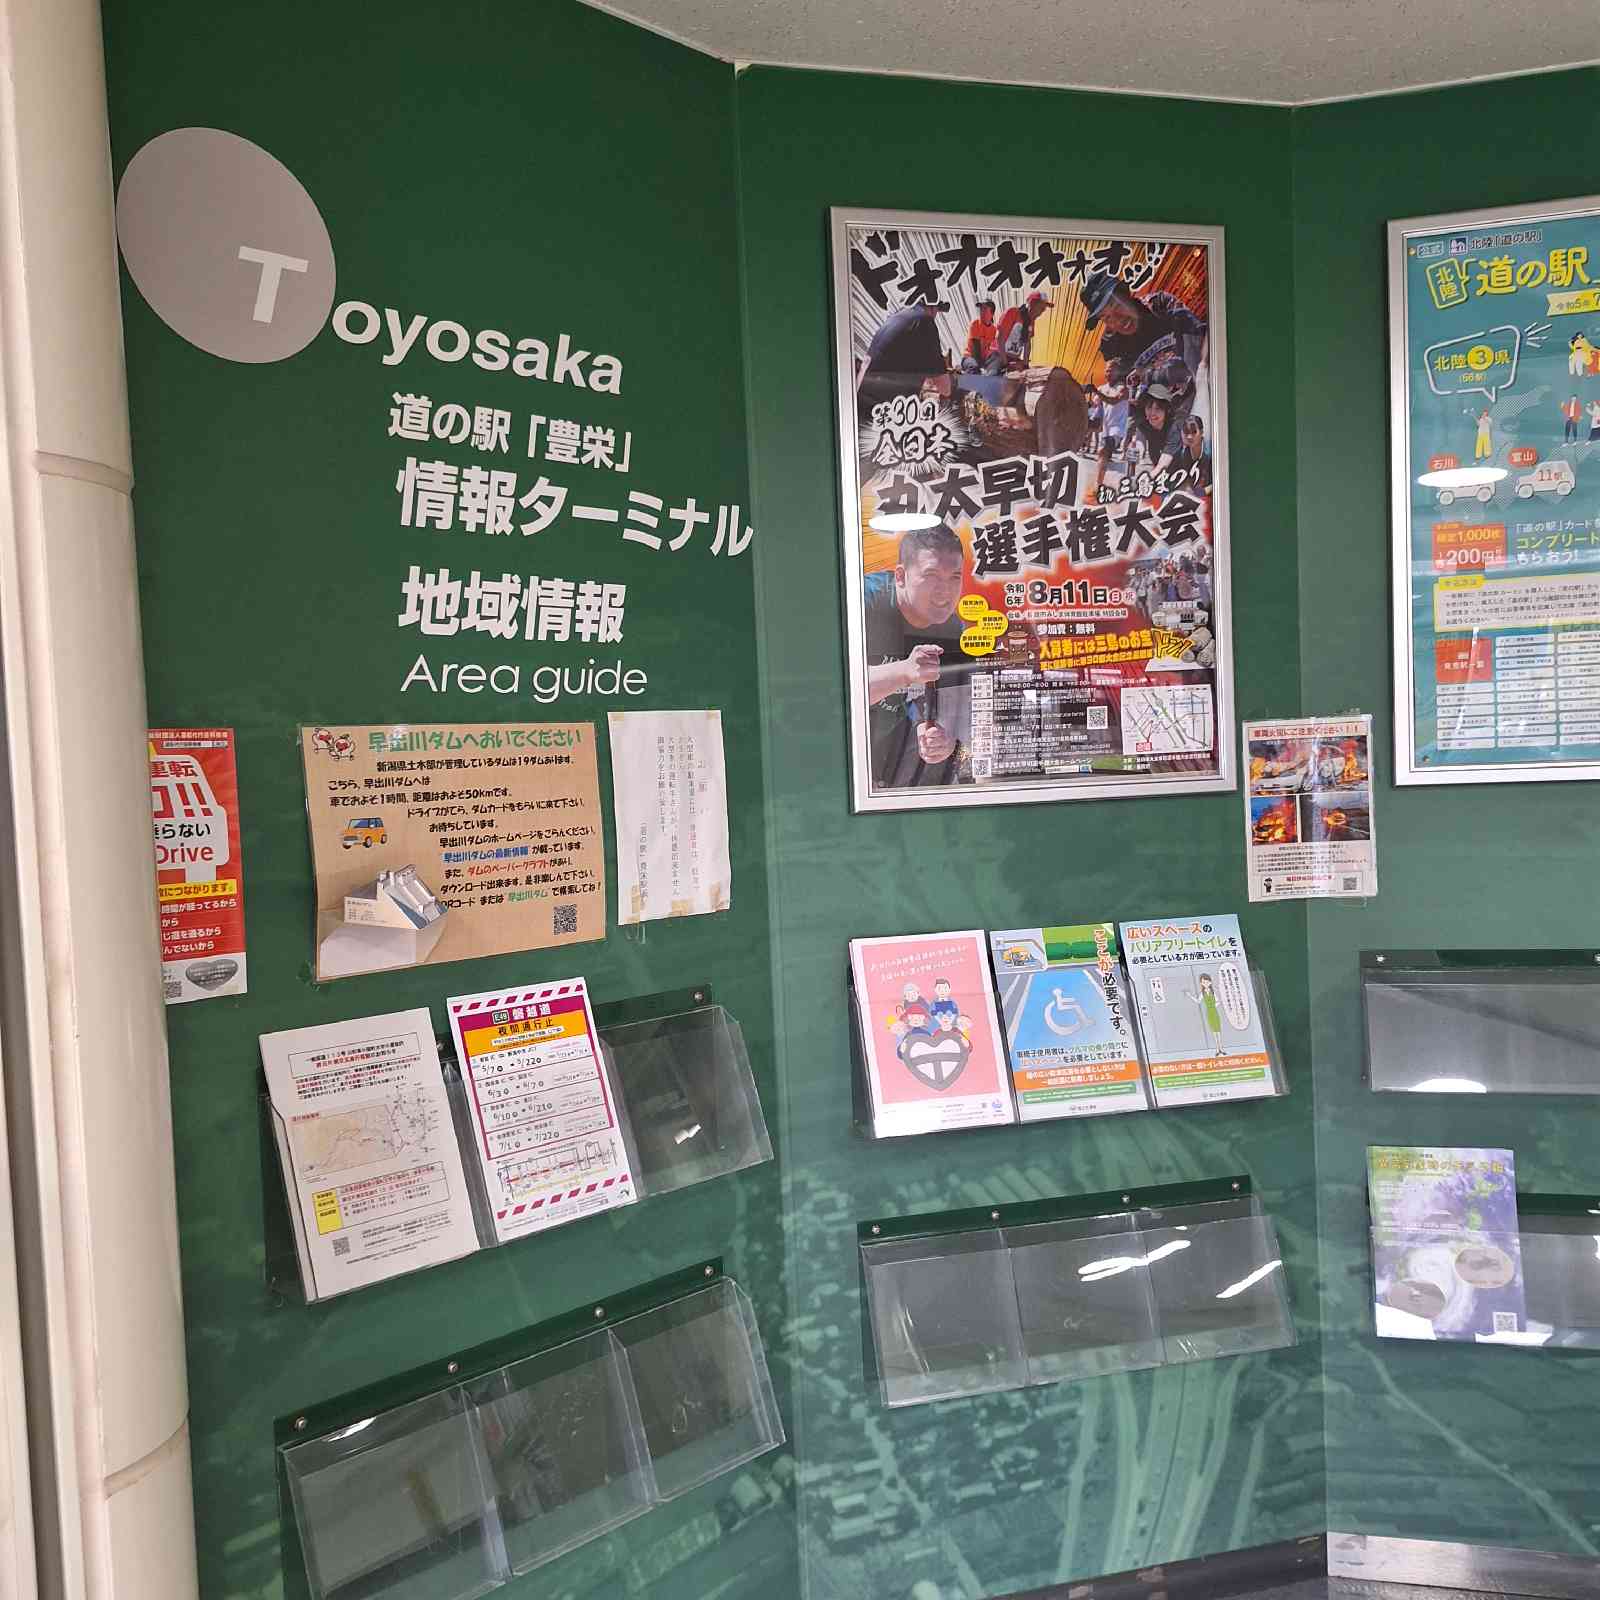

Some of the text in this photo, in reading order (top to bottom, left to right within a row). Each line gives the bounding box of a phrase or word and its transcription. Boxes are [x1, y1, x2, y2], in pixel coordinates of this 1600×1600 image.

[1436, 267, 1460, 302] 北陸
[387, 392, 633, 474] 道の駅「豊栄」
[873, 426, 954, 464] 全日本
[395, 456, 755, 557] 情報ターミナル
[972, 492, 1201, 576] 選手権大会
[398, 565, 628, 645] 地域情報
[400, 655, 648, 704] Area guide
